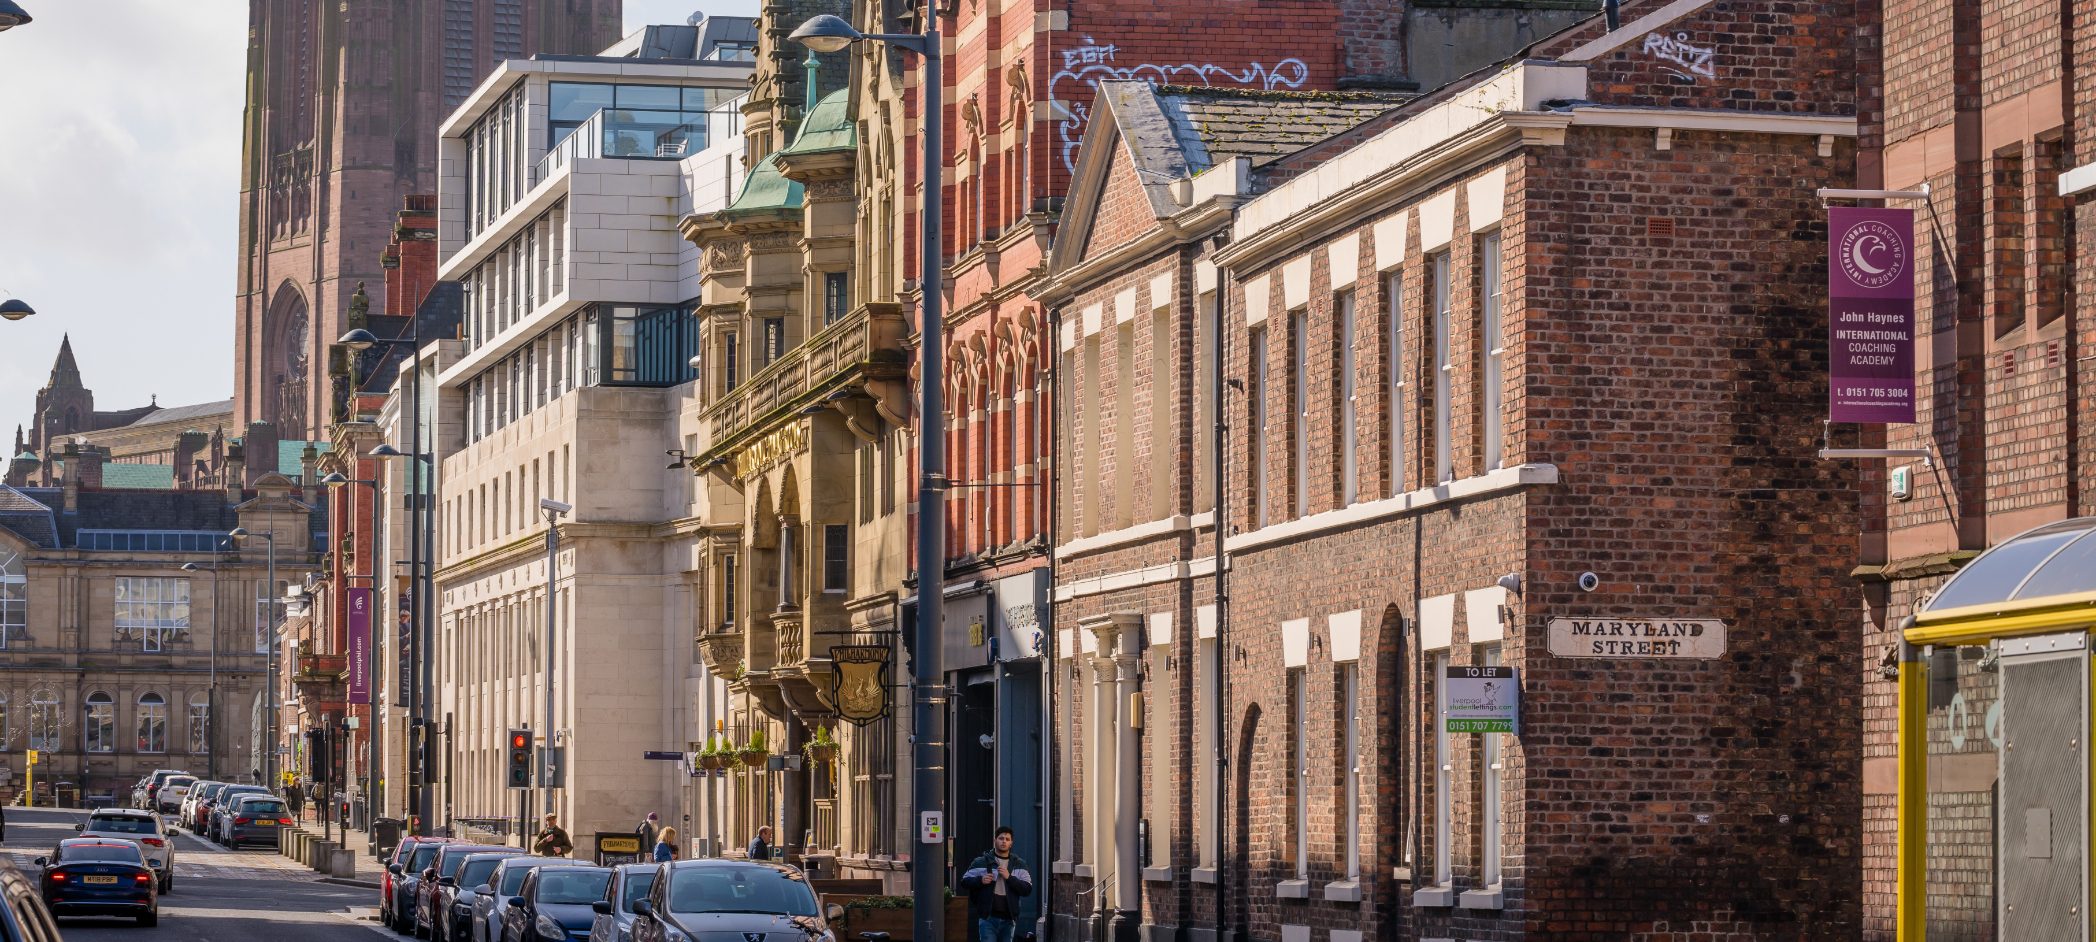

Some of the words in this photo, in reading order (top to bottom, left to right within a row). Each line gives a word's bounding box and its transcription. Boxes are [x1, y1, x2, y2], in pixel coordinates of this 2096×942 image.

[1871, 224, 1901, 258] COACHING
[1843, 225, 1868, 281] INTERNATIONAL
[1864, 261, 1900, 285] ACADEMY
[1840, 311, 1865, 322] John
[1867, 312, 1905, 325] Haynes
[1836, 329, 1909, 341] INTERNATIONAL
[1848, 342, 1896, 353] COACHING
[1850, 355, 1895, 366] ACADEMY
[1846, 387, 1867, 397] 0151
[1869, 388, 1886, 397] 705
[1887, 388, 1909, 398] 3004
[1572, 621, 1704, 637] MARYLAND
[1592, 640, 1681, 656] STREET
[1466, 667, 1480, 677] TO
[1482, 667, 1497, 677] LET
[1449, 721, 1470, 731] 0151
[1472, 721, 1489, 731] 707
[1492, 721, 1513, 731] 7799
